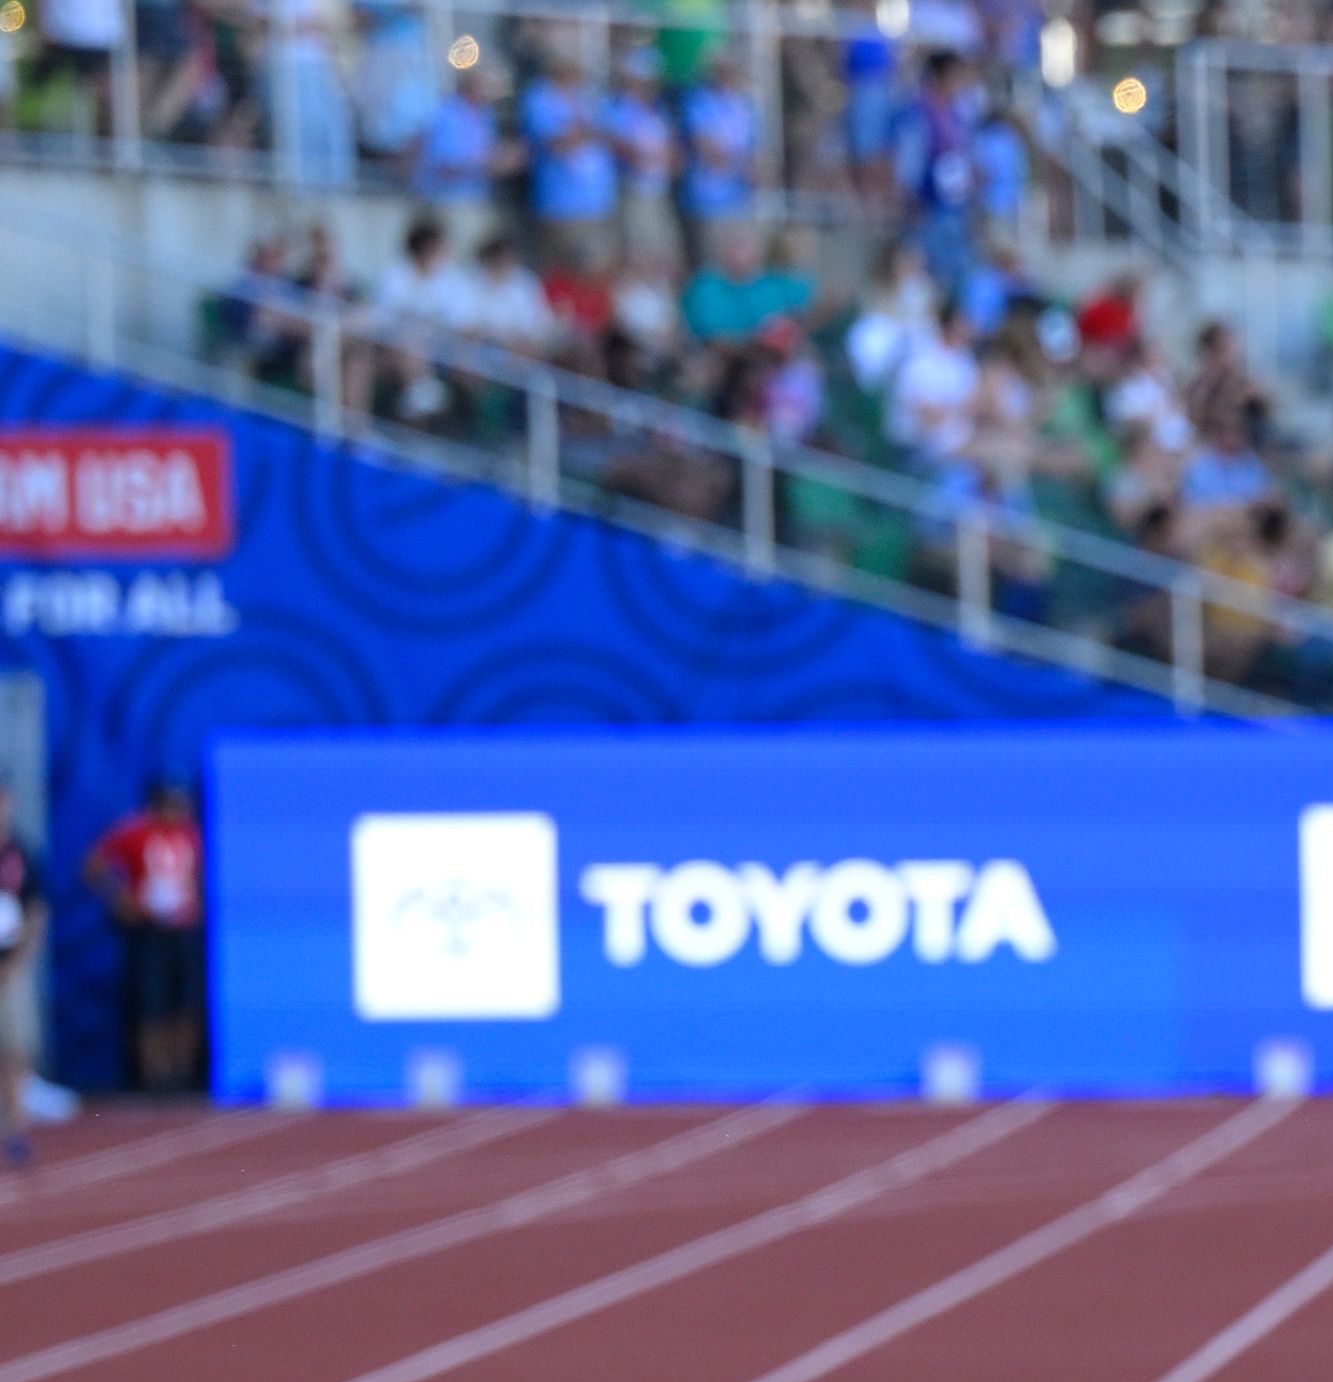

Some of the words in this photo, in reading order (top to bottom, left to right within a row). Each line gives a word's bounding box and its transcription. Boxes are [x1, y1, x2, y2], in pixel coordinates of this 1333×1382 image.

[75, 448, 208, 534] USA
[4, 570, 121, 637] FOR
[125, 570, 241, 637] ALL
[578, 858, 1055, 967] TOYOTA
